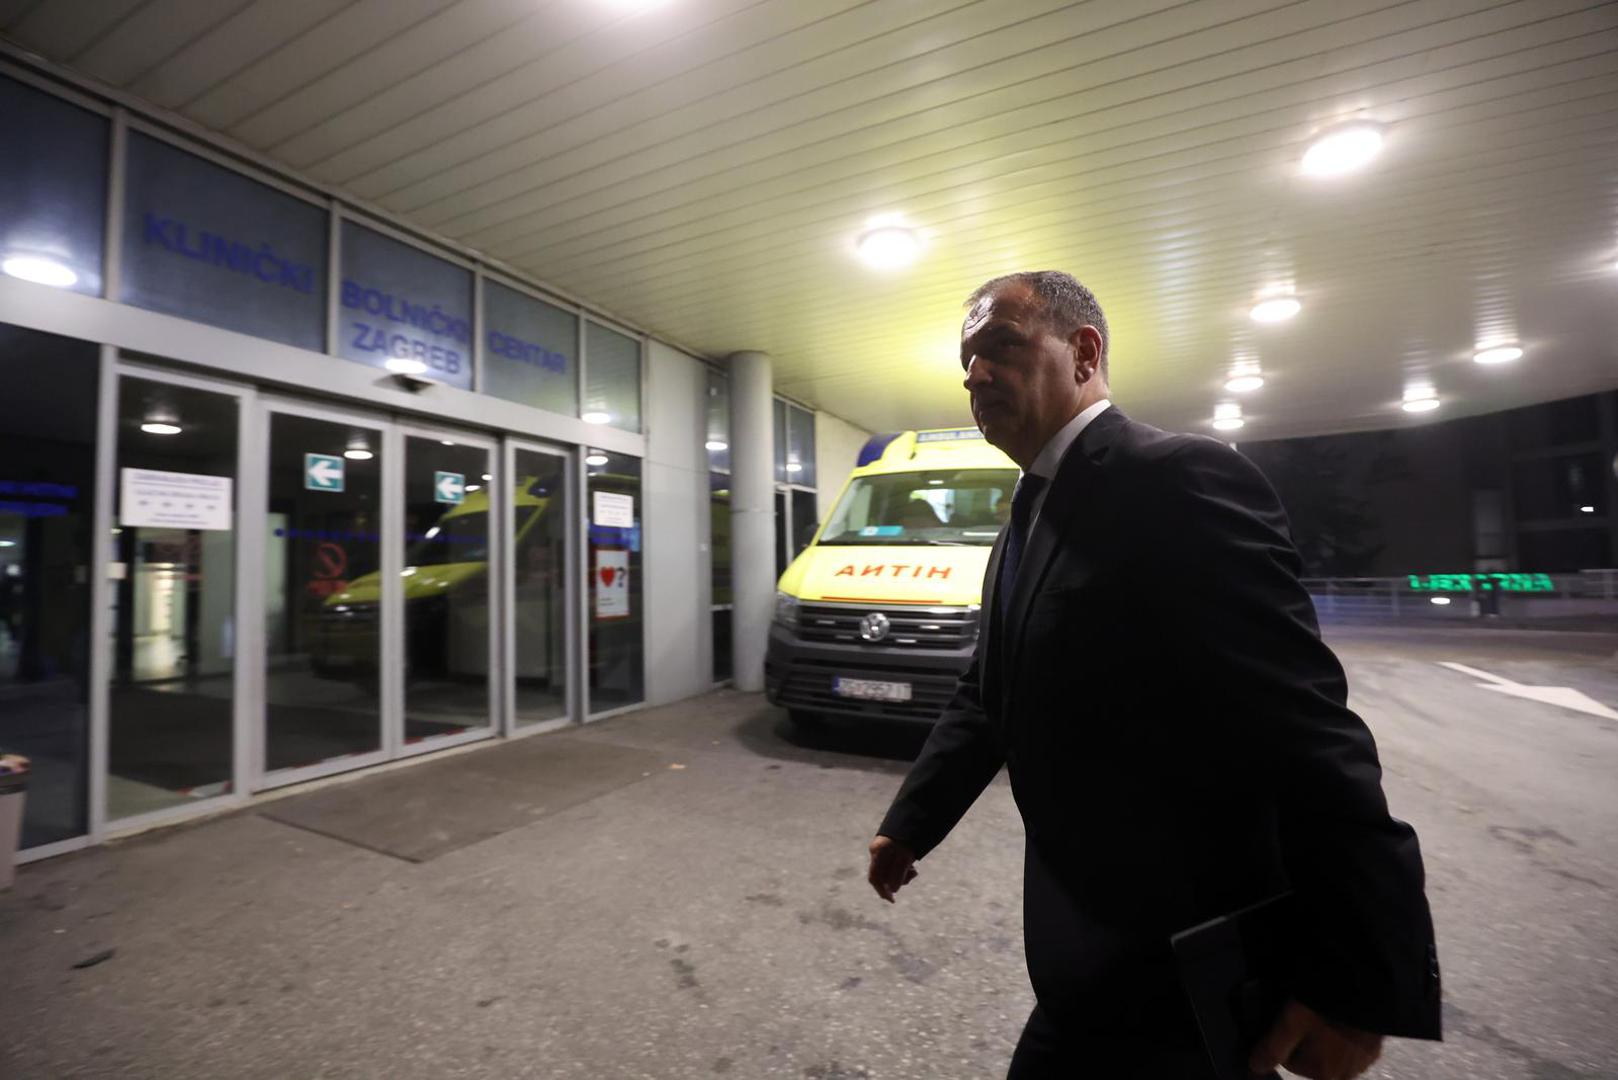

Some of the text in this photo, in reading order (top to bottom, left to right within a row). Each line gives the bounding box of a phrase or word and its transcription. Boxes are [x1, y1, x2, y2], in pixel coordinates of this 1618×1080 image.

[143, 212, 314, 294] KLINIČKI
[489, 330, 566, 374] CENTAR
[352, 323, 461, 375] ZAGREB
